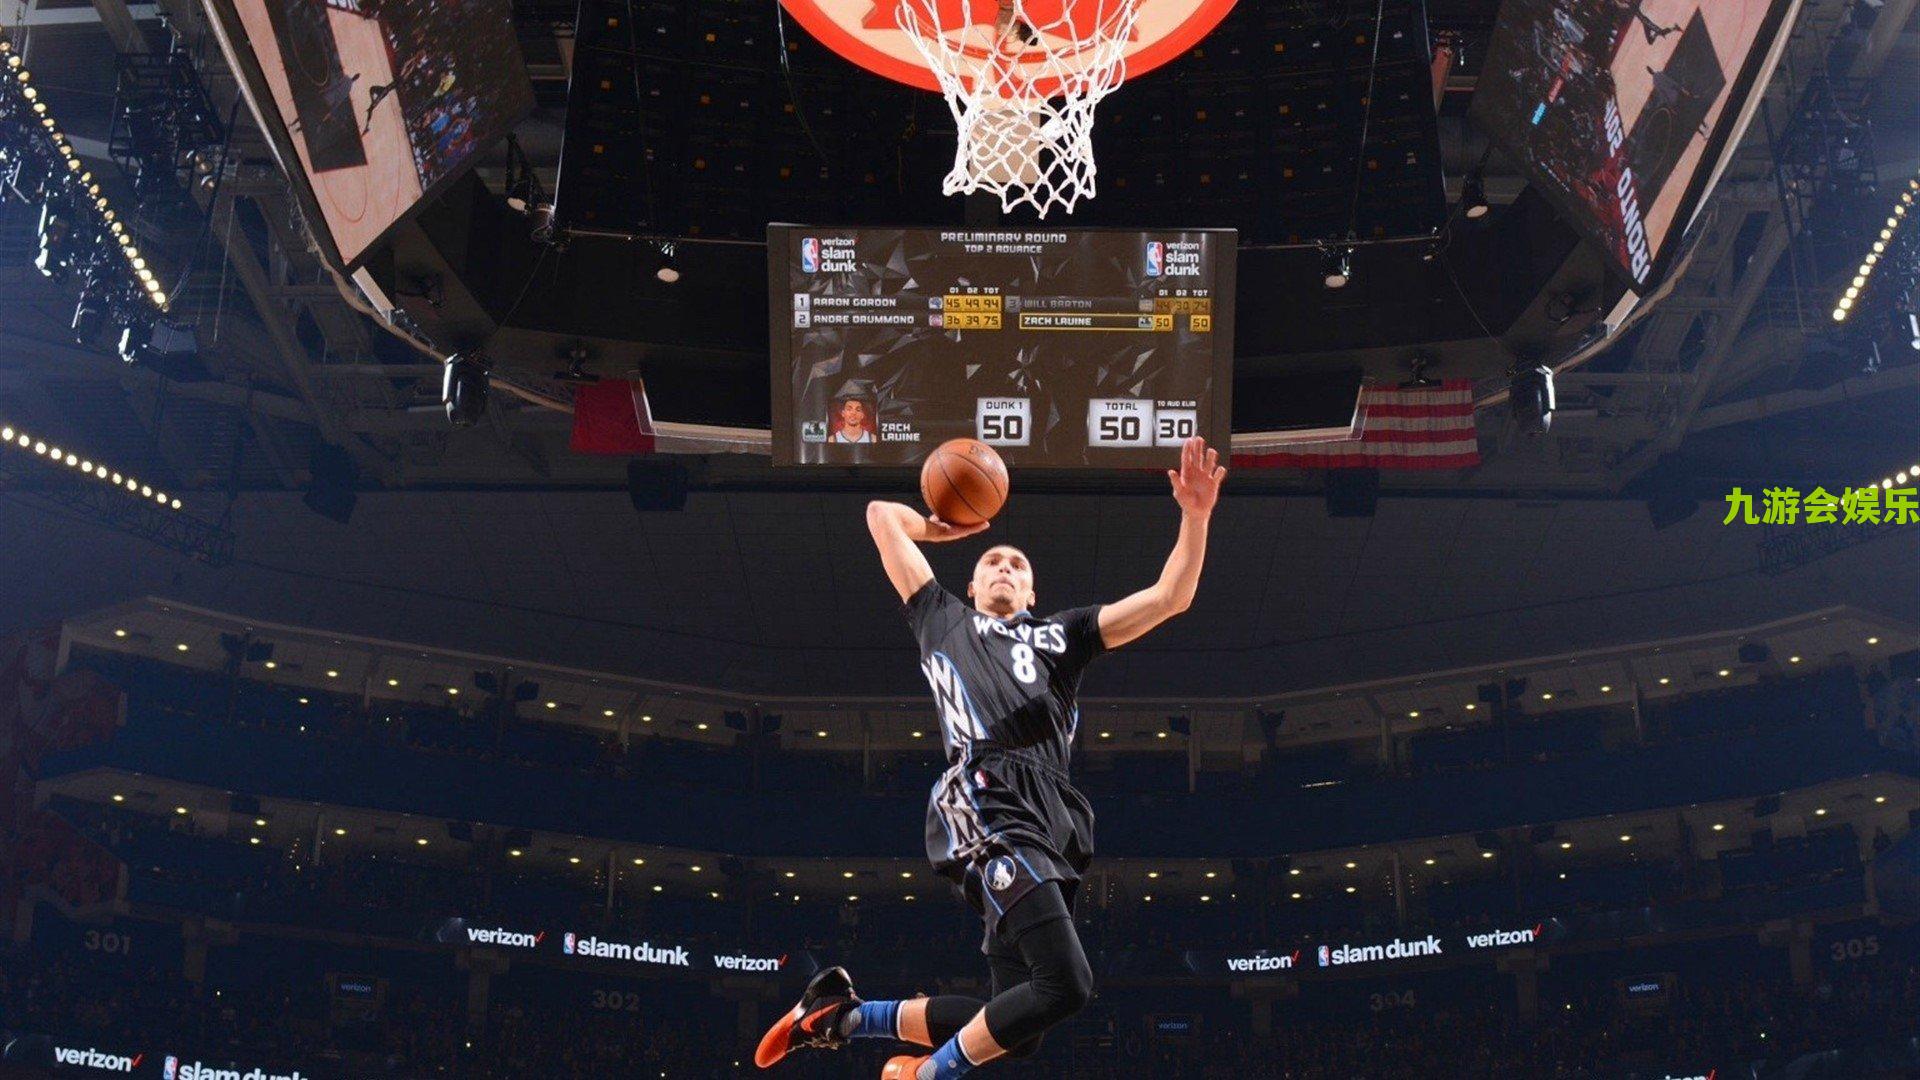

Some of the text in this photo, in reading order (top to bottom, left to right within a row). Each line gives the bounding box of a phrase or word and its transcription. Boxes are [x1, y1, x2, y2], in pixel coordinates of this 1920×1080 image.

[821, 237, 854, 246] verizon
[941, 232, 1067, 243] PRELIMINARY ROUND
[821, 246, 855, 259] slam
[965, 244, 984, 253] TOP
[986, 245, 993, 253] 2
[1166, 241, 1200, 250] verizon
[1165, 250, 1200, 263] slam
[821, 259, 857, 272] dunk
[1164, 263, 1200, 276] dunk
[813, 298, 850, 307] AARON
[853, 298, 896, 308] GORDON
[965, 299, 980, 308] 49
[984, 299, 999, 308] 94
[813, 315, 849, 324] ANDRE
[853, 315, 915, 325] DRUMMOND
[966, 315, 979, 325] 39
[984, 315, 998, 326] 75
[1024, 316, 1052, 325] ZACH
[1156, 317, 1169, 327] 50
[1193, 318, 1208, 327] 50
[986, 401, 1015, 410] DUNK
[1105, 402, 1138, 411] TOTAL
[881, 423, 911, 432] ZACH
[983, 415, 1023, 440] 50
[1100, 416, 1140, 441] 50
[1159, 418, 1193, 438] 30
[881, 432, 921, 442] LAVINE
[973, 615, 1067, 654] WOLVES
[1011, 642, 1037, 684] 8
[84, 930, 132, 955] 301
[467, 927, 535, 948] verizon
[1466, 926, 1533, 949] verizon
[577, 936, 690, 967] slam dunk
[1331, 934, 1443, 965] slam dunk
[1830, 935, 1880, 961] 305
[714, 953, 779, 971] verizon
[1227, 953, 1292, 972] verizon
[592, 989, 641, 1012] 302
[55, 1046, 132, 1072] verizon
